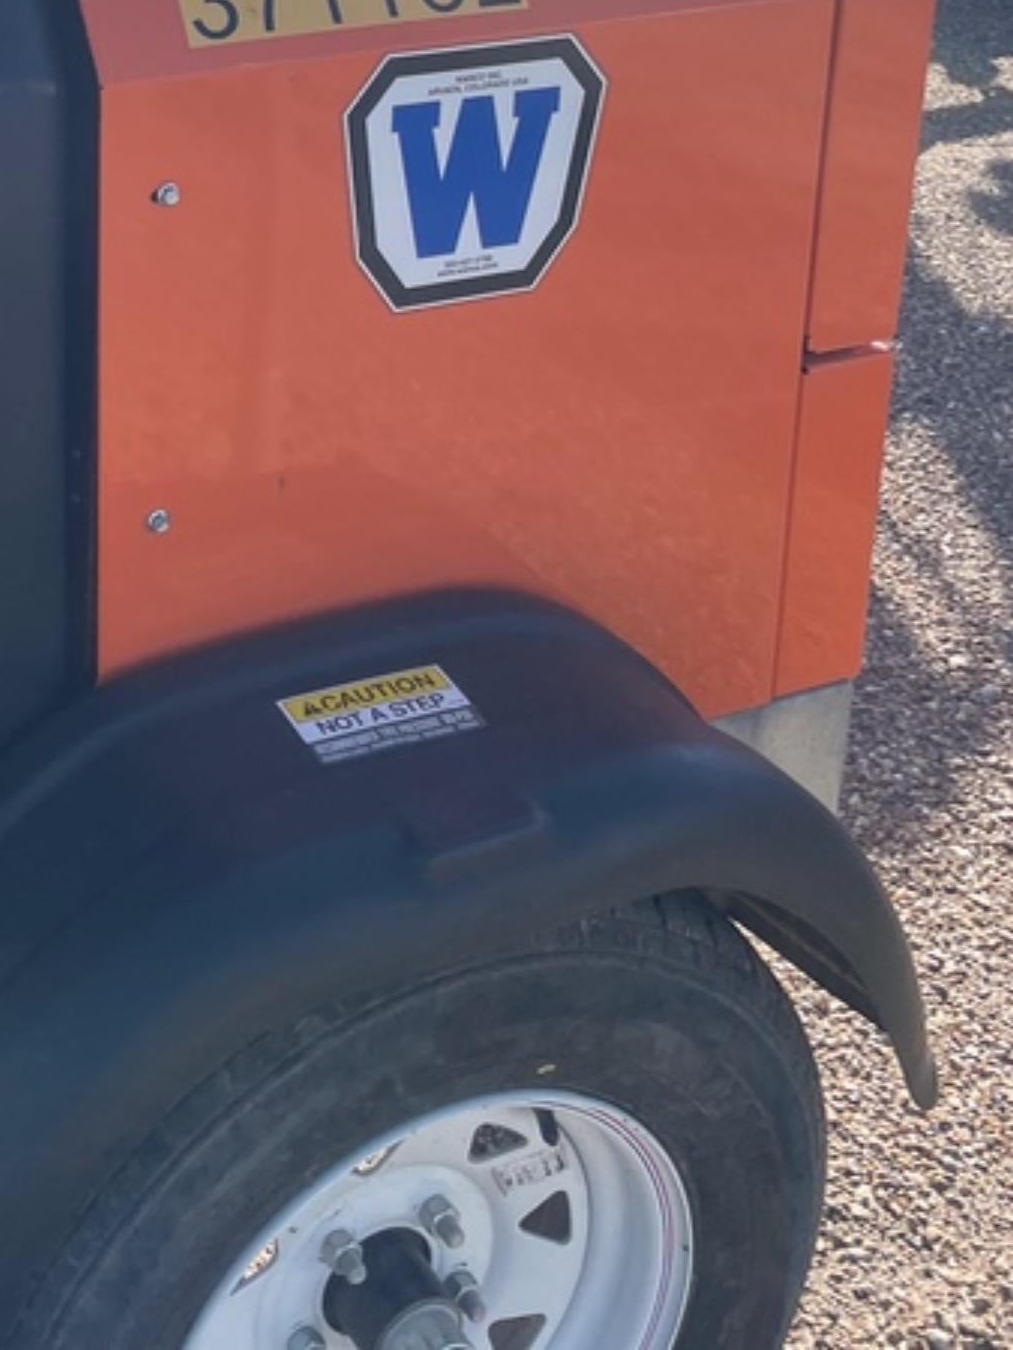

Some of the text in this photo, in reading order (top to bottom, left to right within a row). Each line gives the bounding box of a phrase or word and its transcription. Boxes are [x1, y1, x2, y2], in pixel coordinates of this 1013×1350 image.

[391, 85, 561, 259] W
[316, 693, 445, 735] NOT A STEP
[321, 672, 436, 715] CAUTION
